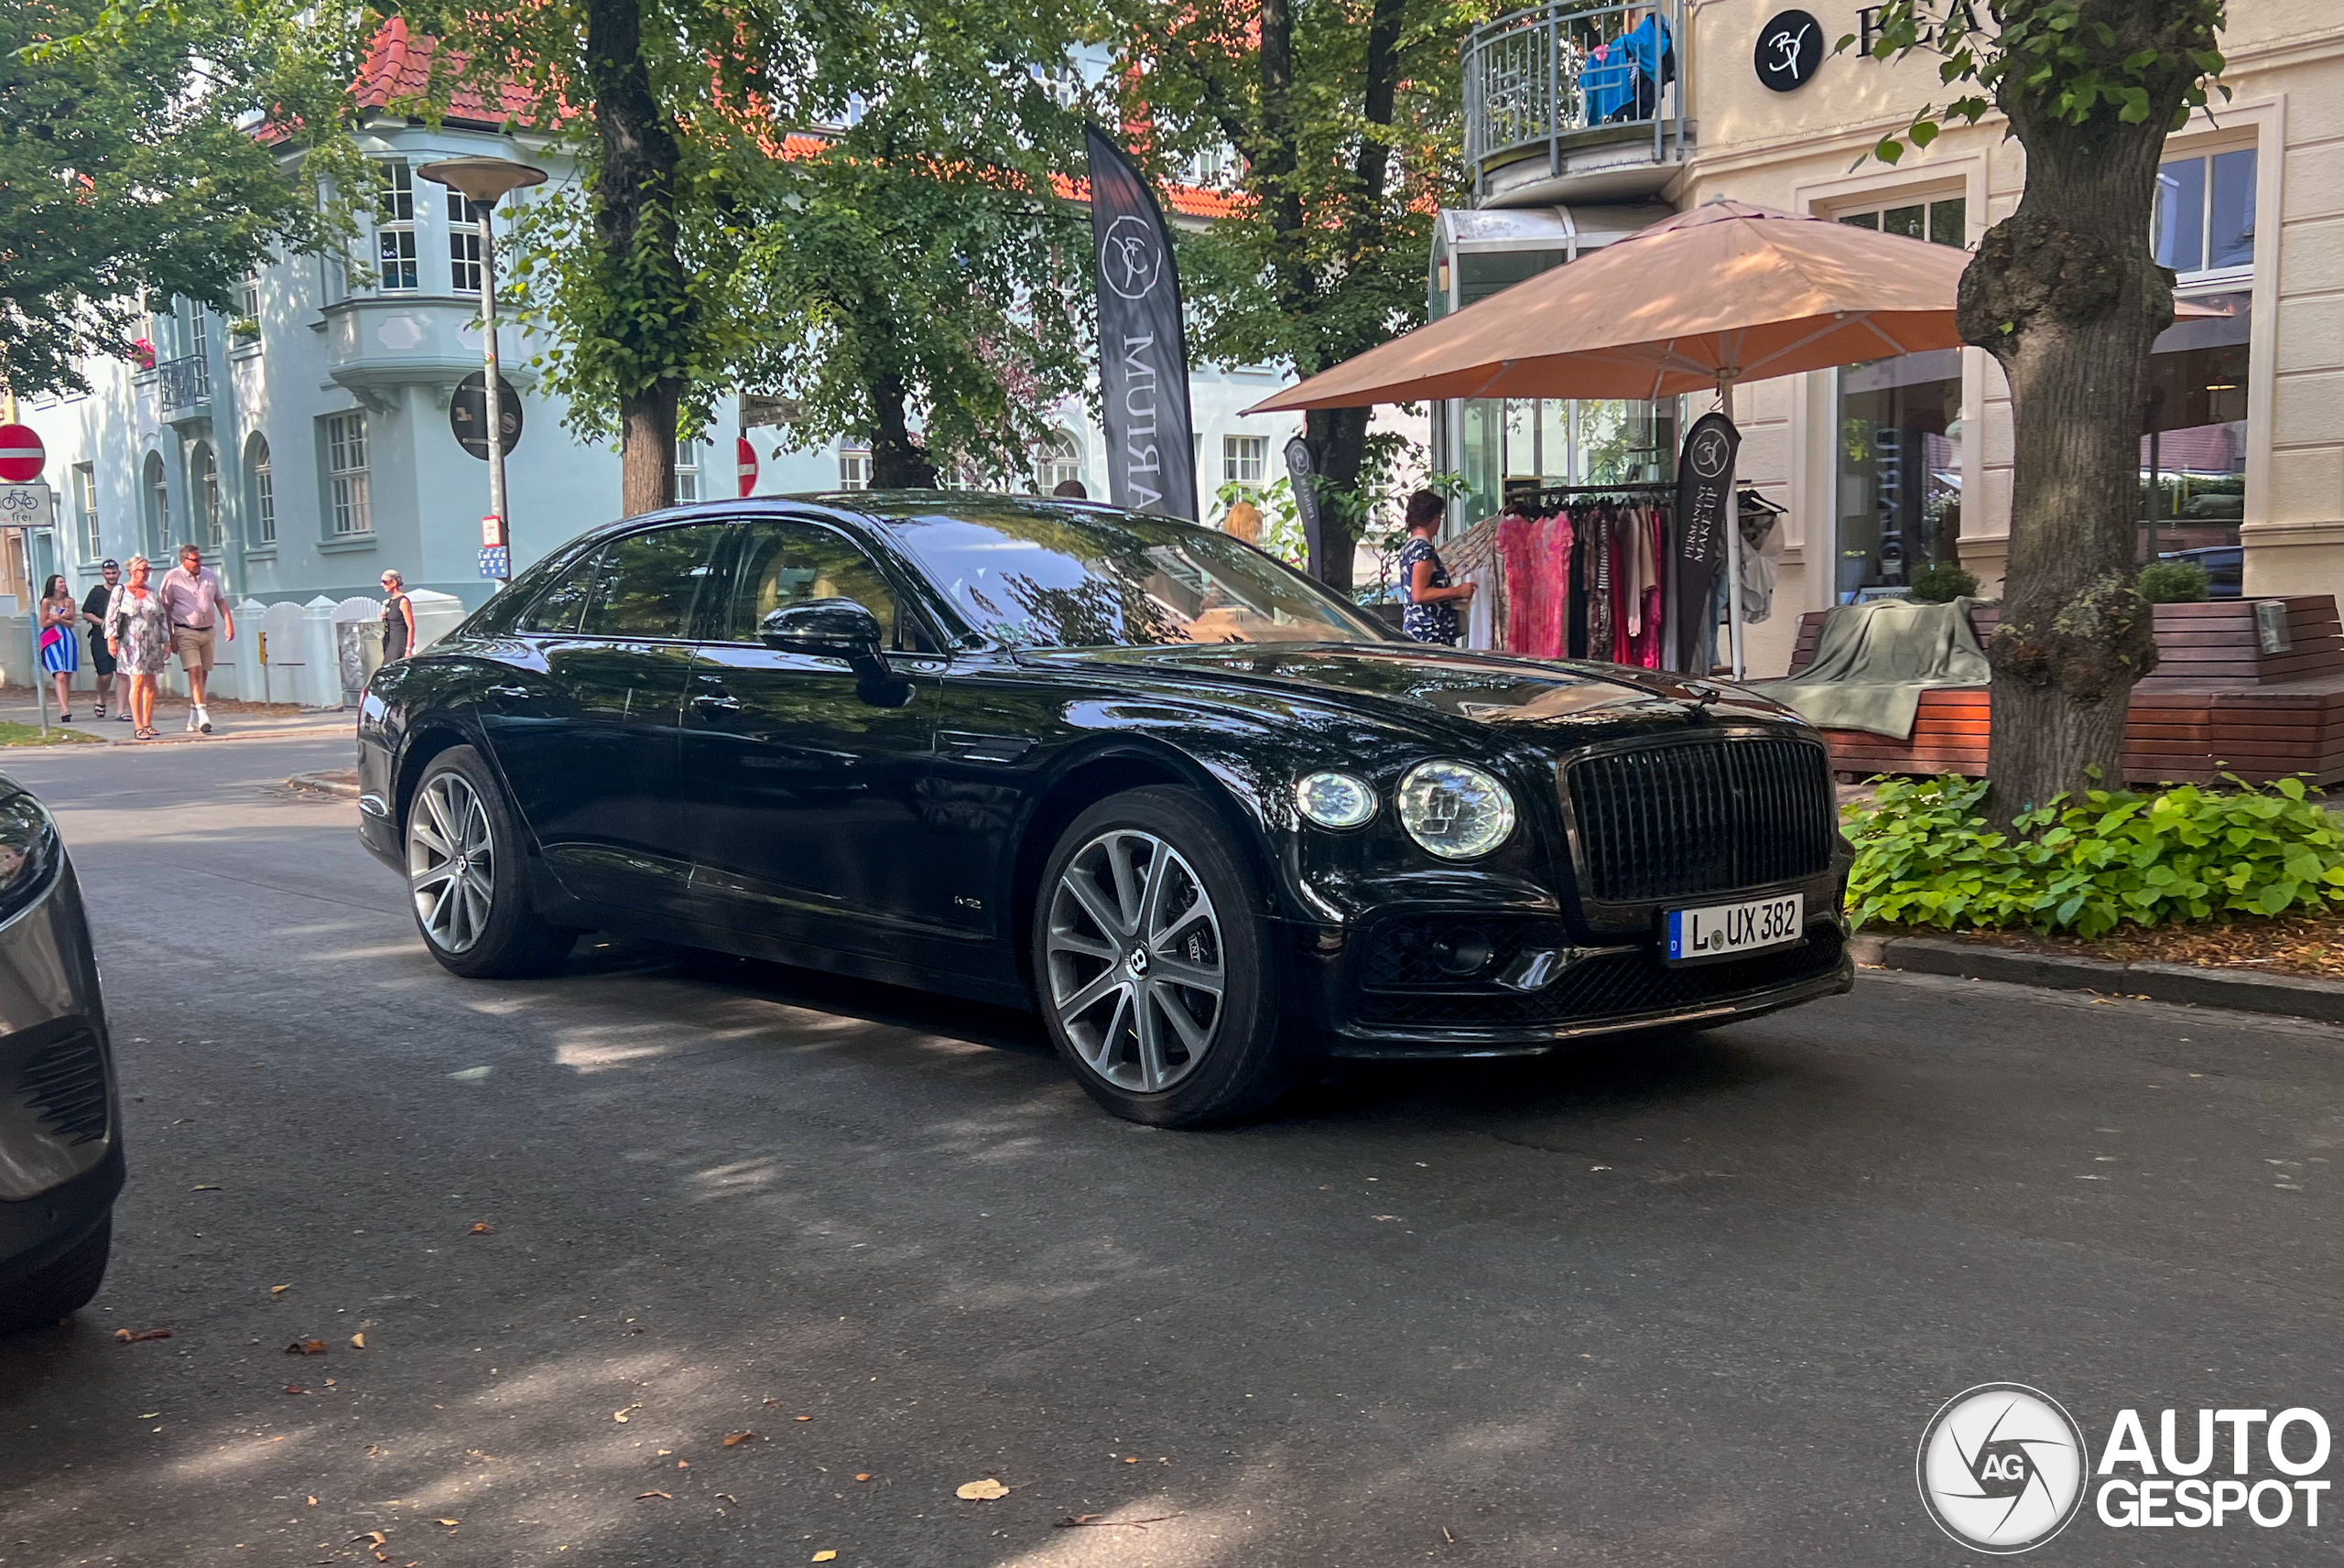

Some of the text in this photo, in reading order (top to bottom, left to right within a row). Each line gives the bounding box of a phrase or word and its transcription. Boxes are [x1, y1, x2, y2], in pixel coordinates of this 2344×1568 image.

[12, 512, 32, 523] frei
[1685, 483, 1708, 559] PERMANENT
[1694, 486, 1719, 563] MAKE-UP
[1670, 900, 1796, 952] D L UX 382
